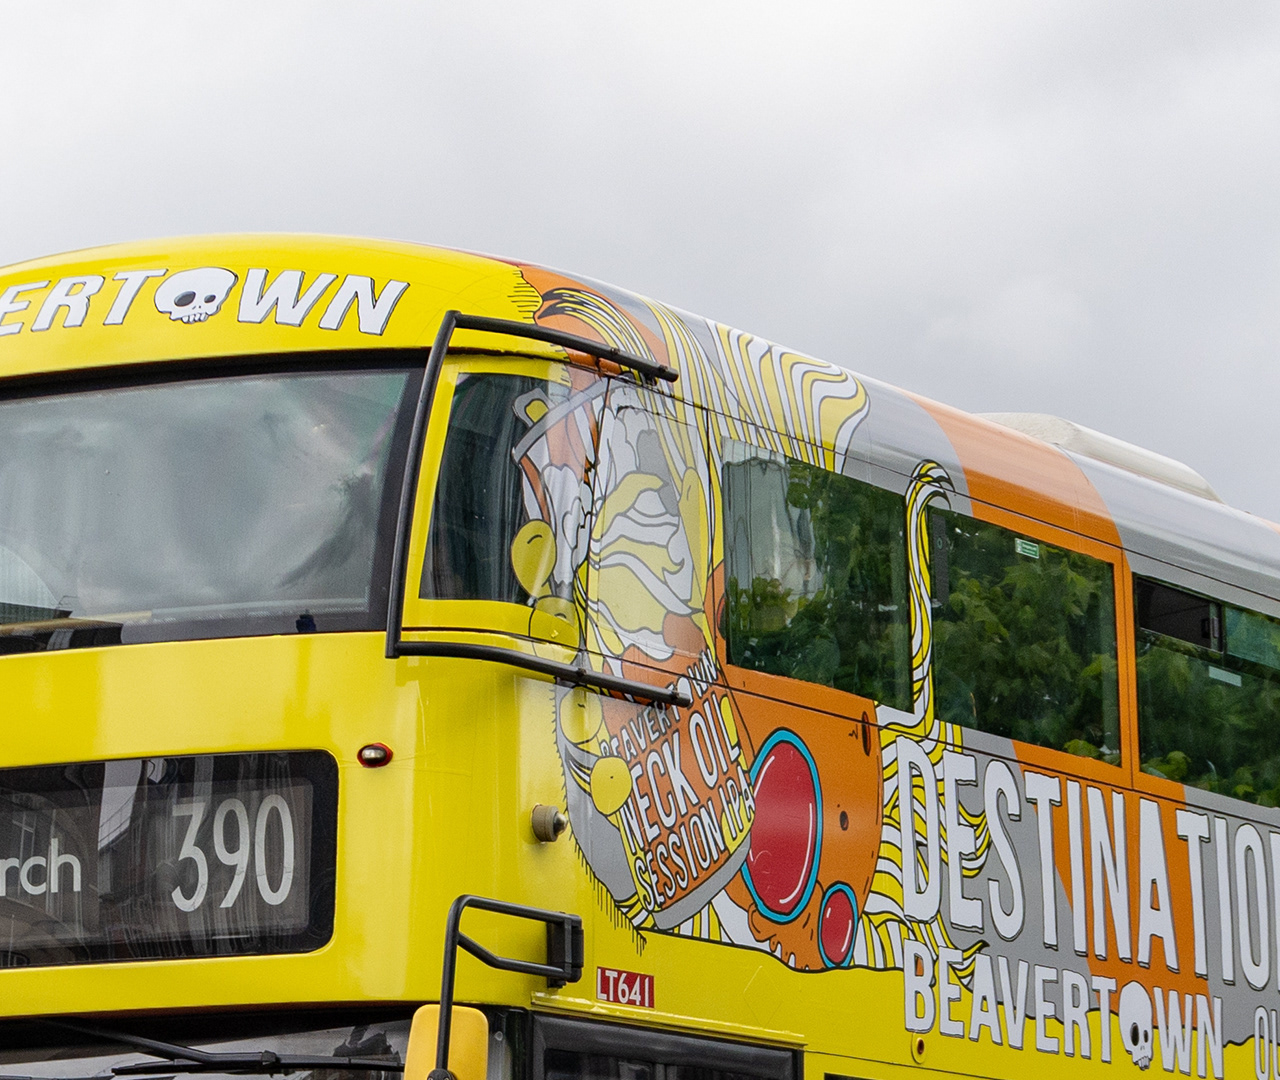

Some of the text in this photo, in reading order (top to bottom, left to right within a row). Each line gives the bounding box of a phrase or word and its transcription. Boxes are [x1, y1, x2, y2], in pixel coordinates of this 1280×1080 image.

[620, 692, 741, 855] NECK OIL
[634, 766, 756, 911] SESSION IPA
[169, 793, 295, 913] 390
[598, 967, 654, 1007] LT641
